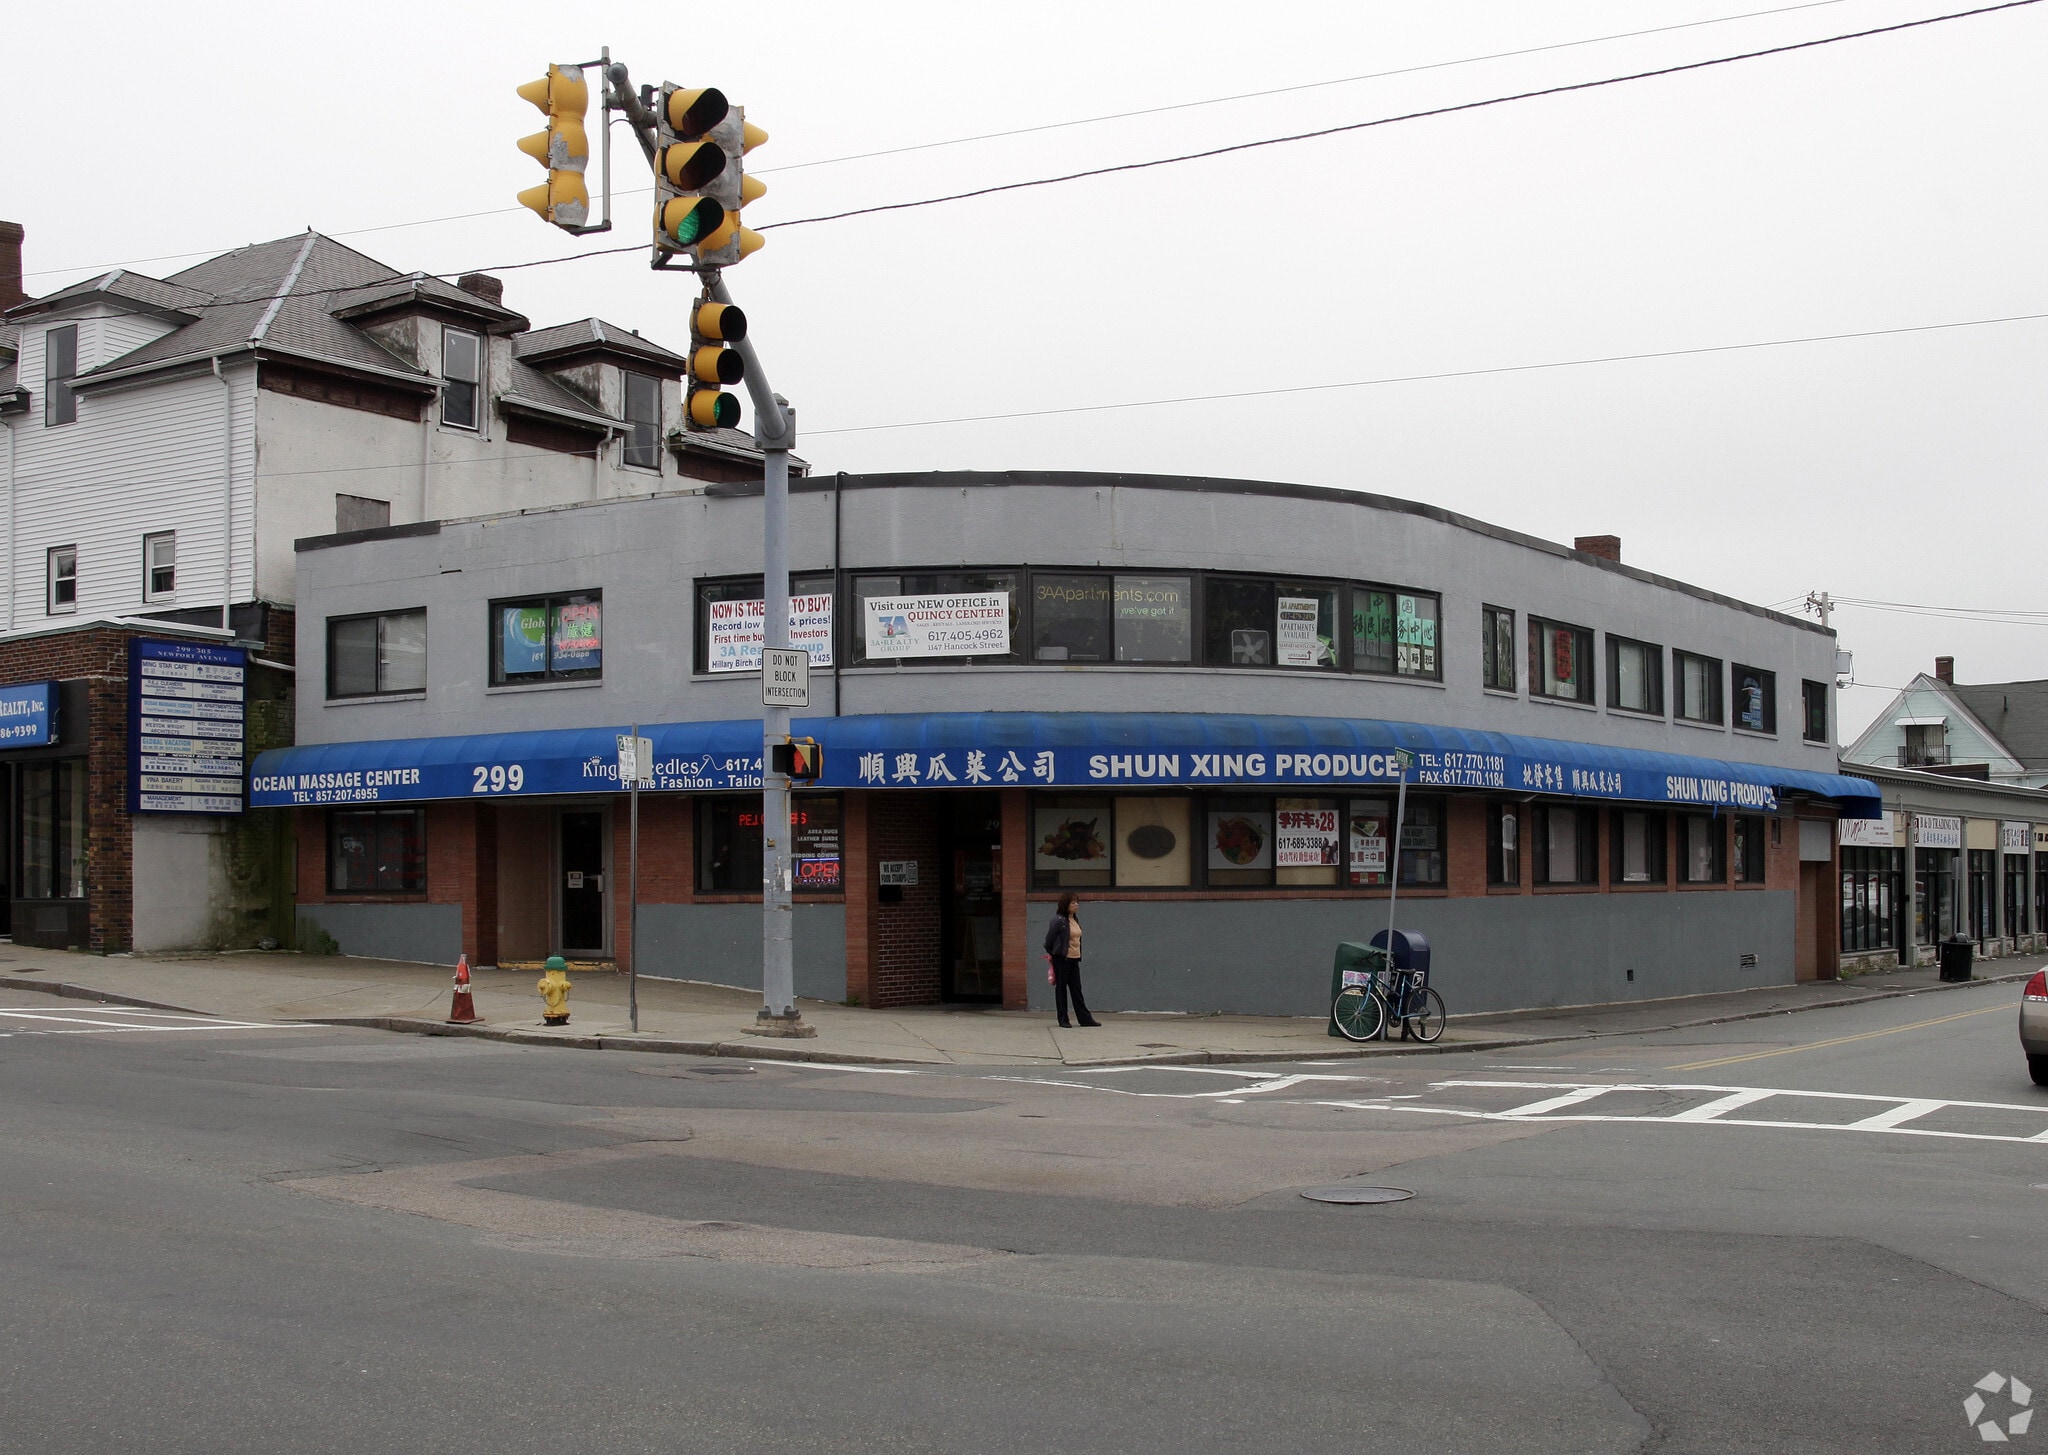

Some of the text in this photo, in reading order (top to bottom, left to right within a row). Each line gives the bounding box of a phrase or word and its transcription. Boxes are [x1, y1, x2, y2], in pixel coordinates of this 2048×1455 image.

[712, 600, 764, 619] NOW IS THE
[792, 597, 830, 614] TO BUY!
[870, 601, 894, 611] Visit
[918, 599, 944, 610] NEW
[946, 598, 986, 608] OFFICE
[988, 598, 999, 607] in
[908, 608, 1004, 622] QUINCY CENTER!
[1150, 606, 1166, 616] got
[1168, 606, 1174, 615] it
[520, 617, 554, 629] Globl
[712, 620, 760, 631] Record low
[800, 616, 831, 627] prices!
[1280, 623, 1315, 632] APARTMENTS
[714, 634, 731, 644] First
[734, 633, 750, 642] time
[790, 629, 828, 640] Investors
[928, 629, 1004, 642] 617.405.4962
[720, 646, 736, 656] 3A
[944, 642, 978, 650] Hancock
[158, 650, 195, 659] NEWPORT
[773, 654, 798, 666] DO NOT
[712, 659, 752, 670] Hillary Birch
[775, 670, 796, 682] BLOCK
[766, 687, 806, 698] INTERSECTION
[859, 750, 1056, 784] 順興瓜菜公司
[1089, 754, 1400, 778] SHUN XING PRODUCE
[1419, 753, 1504, 772] TEL: 617.770.1181
[252, 768, 420, 792] OCEAN MASSAGE CENTER
[472, 764, 524, 792] 299
[622, 779, 656, 790] Hme
[660, 775, 712, 788] Fashion
[1420, 769, 1504, 786] FAX: 617.770.1184
[1572, 768, 1622, 794] 順興瓜菜公司
[1666, 775, 1699, 800] SHUN
[1700, 778, 1728, 802] XING
[316, 788, 378, 802] 857-207-6955
[1278, 837, 1322, 849] 617-689-3388
